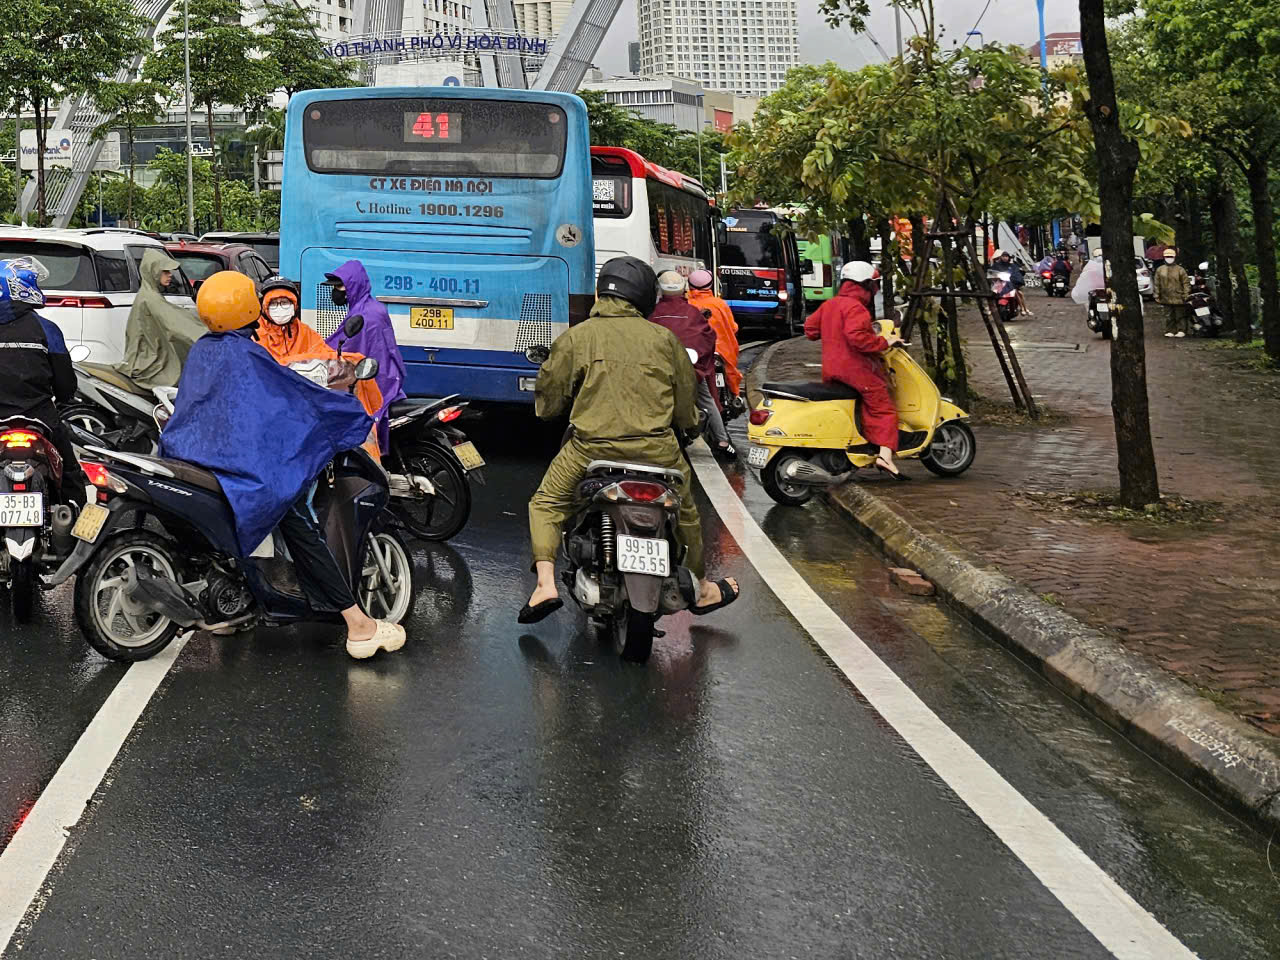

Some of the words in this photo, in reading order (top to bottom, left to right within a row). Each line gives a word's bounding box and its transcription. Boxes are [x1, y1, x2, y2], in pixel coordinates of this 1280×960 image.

[352, 38, 405, 56] THÀNH
[411, 32, 444, 49] PHỐ
[447, 32, 462, 50] VÌ
[467, 33, 502, 50] HÒA
[507, 34, 547, 55] BÌNH
[412, 112, 449, 138] 41
[369, 178, 387, 190] CT
[390, 178, 407, 191] XE
[369, 203, 412, 215] Hotline
[418, 203, 504, 218] 1900.1296
[384, 275, 413, 290] 29B
[429, 277, 480, 294] 400.11
[422, 309, 442, 318] 29B
[415, 319, 449, 328] 400.11
[147, 479, 193, 497] VISION
[4, 495, 36, 509] 35-B3
[0, 510, 40, 524] 077.48
[625, 538, 660, 556] 99-B1
[621, 553, 666, 573] 225.55
